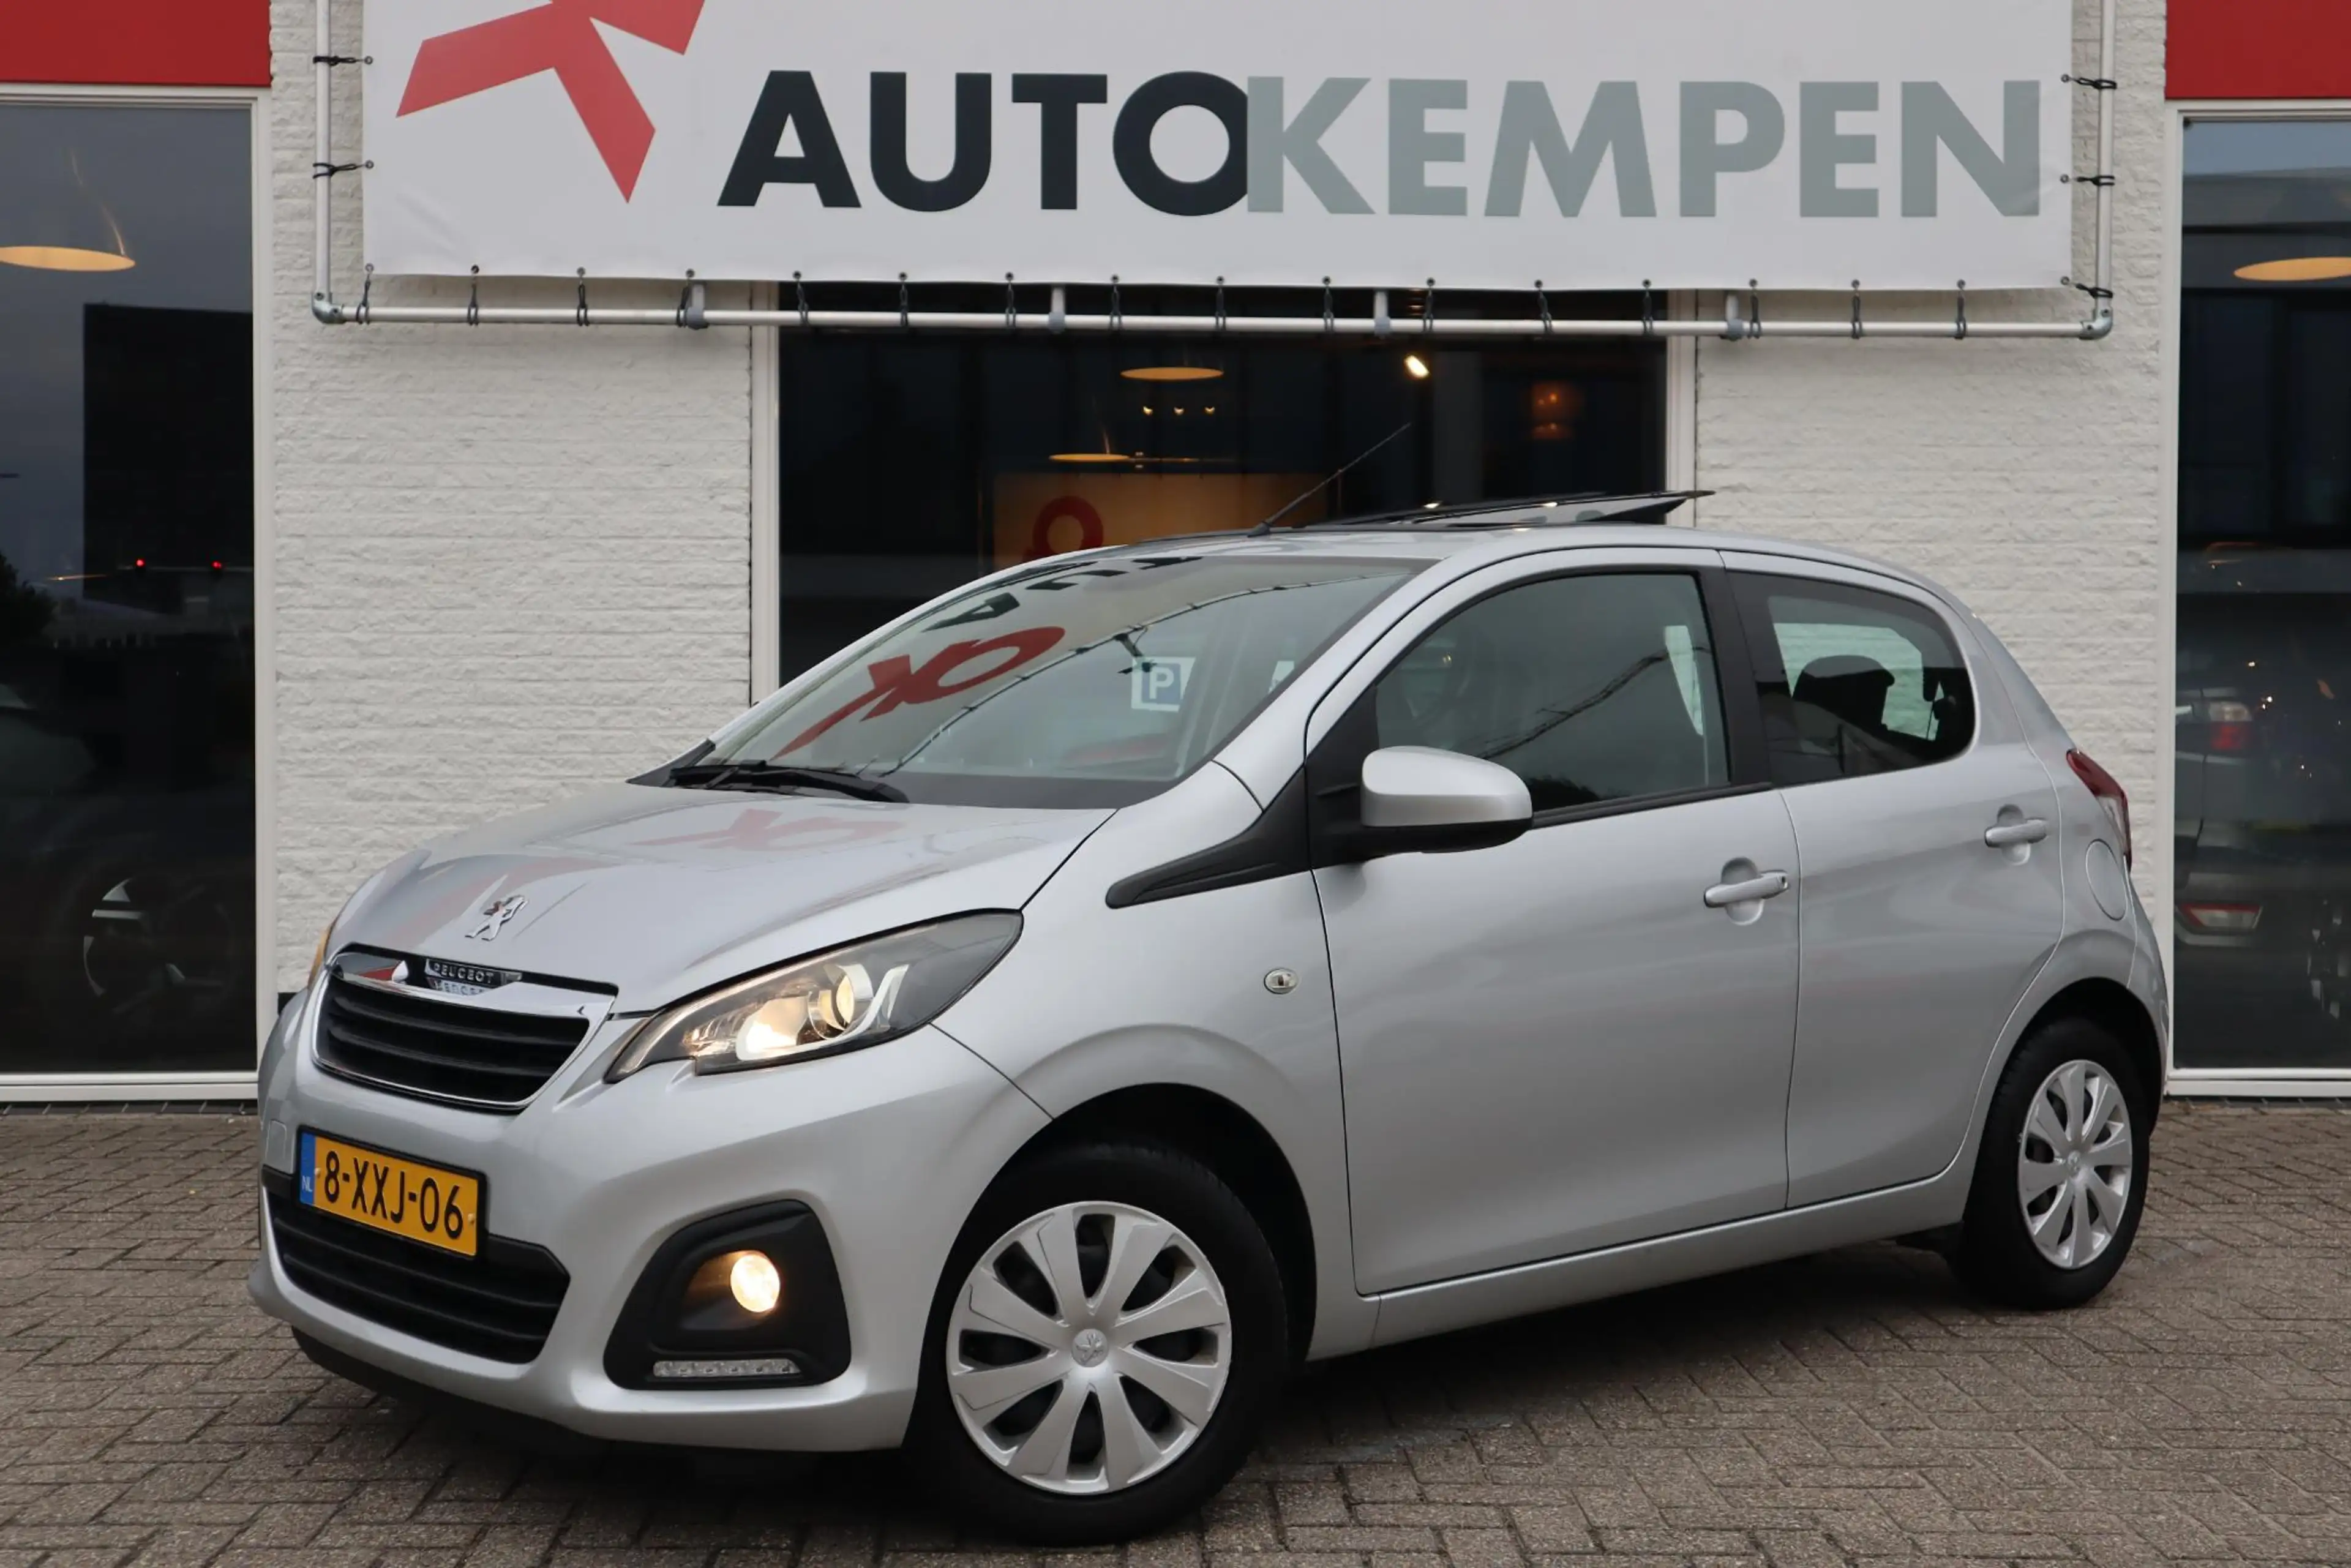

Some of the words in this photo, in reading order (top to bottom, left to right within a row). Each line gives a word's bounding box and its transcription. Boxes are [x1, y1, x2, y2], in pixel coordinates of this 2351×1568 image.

[1149, 666, 1174, 699] P
[433, 962, 493, 984] PEUGEOT
[302, 1175, 313, 1192] NL
[324, 1150, 463, 1239] 8-XXJ-06
